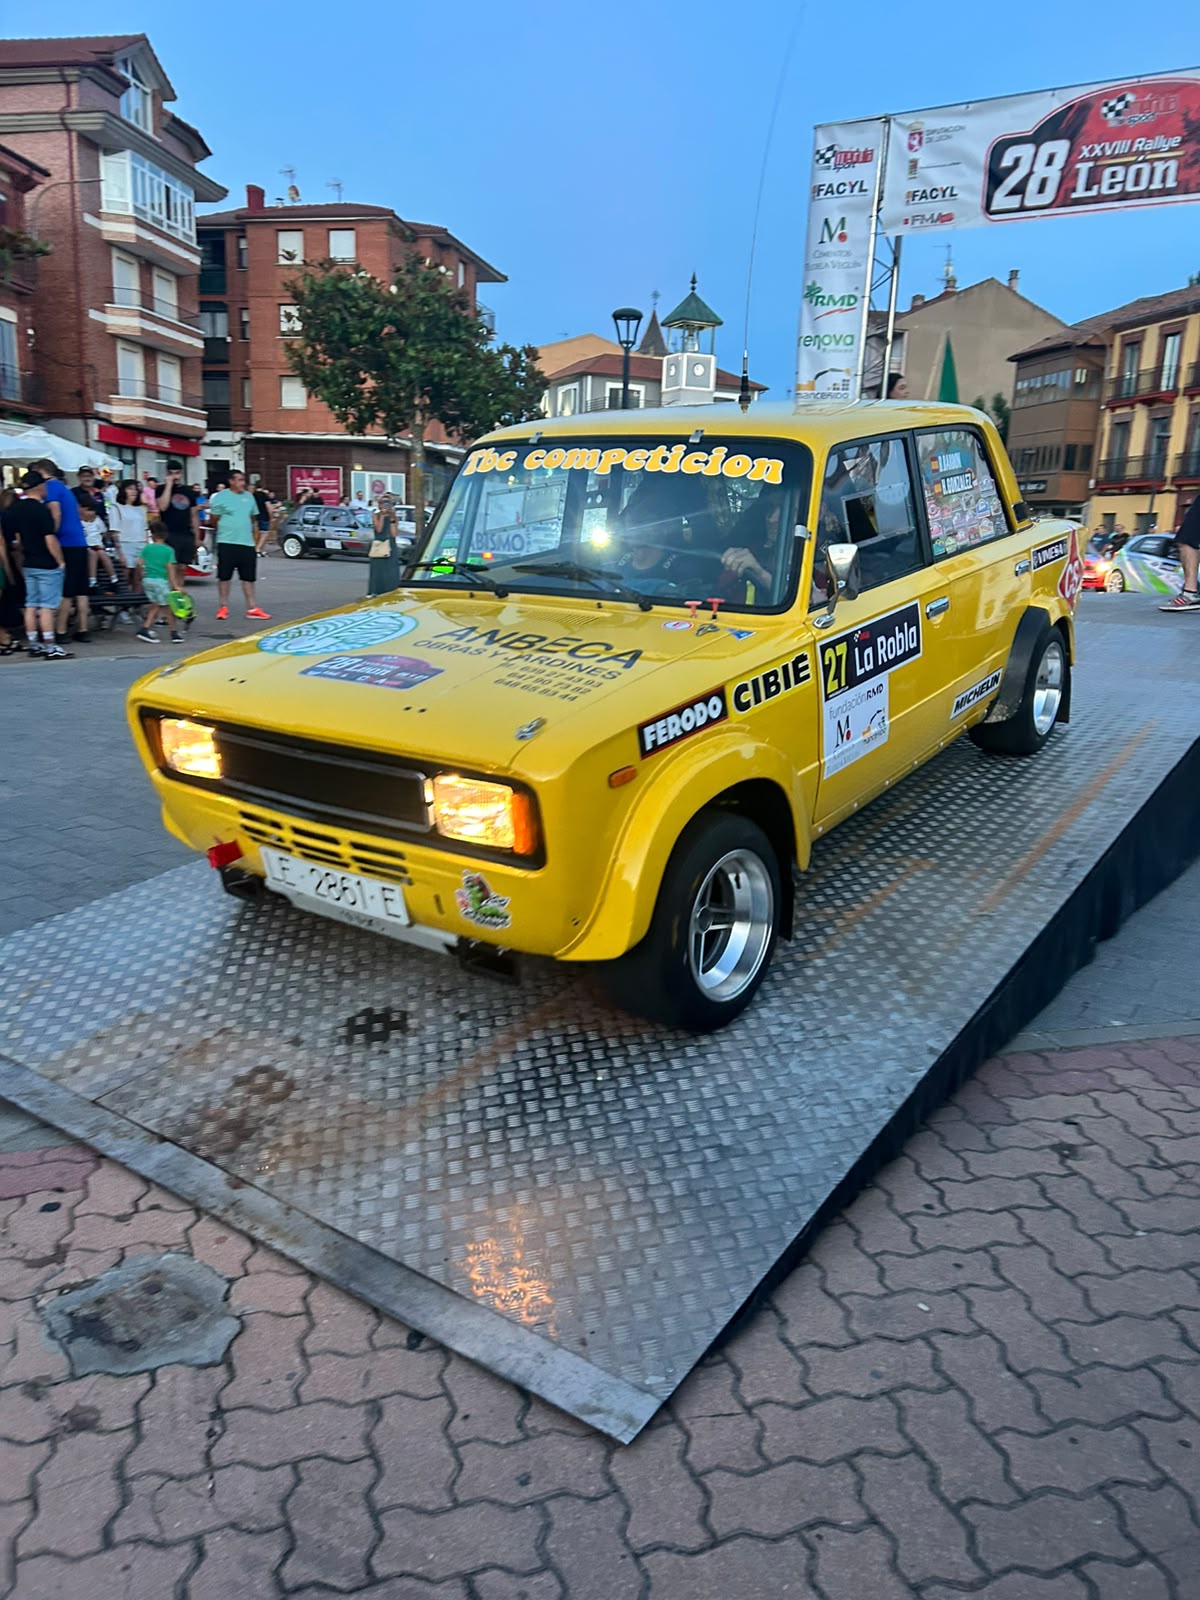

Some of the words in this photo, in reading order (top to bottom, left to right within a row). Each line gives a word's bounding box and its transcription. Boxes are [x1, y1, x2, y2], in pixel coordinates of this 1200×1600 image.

[1078, 139, 1132, 159] XXVIII
[1132, 135, 1183, 152] Rallye
[816, 179, 868, 197] FACYL
[911, 186, 958, 201] FACYL
[990, 139, 1072, 215] 28
[1070, 155, 1179, 199] León
[814, 294, 858, 307] RMD
[462, 447, 517, 476] Tbc
[523, 445, 784, 484] competicion
[412, 639, 484, 656] OBRAS
[487, 649, 502, 659] Y
[503, 650, 622, 680] JARDINES
[432, 626, 644, 669] ANBECA
[824, 641, 848, 694] 27
[854, 646, 874, 677] La
[877, 621, 918, 666] Robla
[953, 672, 1001, 714] MICHELIN
[642, 695, 723, 752] FERODO
[381, 887, 401, 918] E
